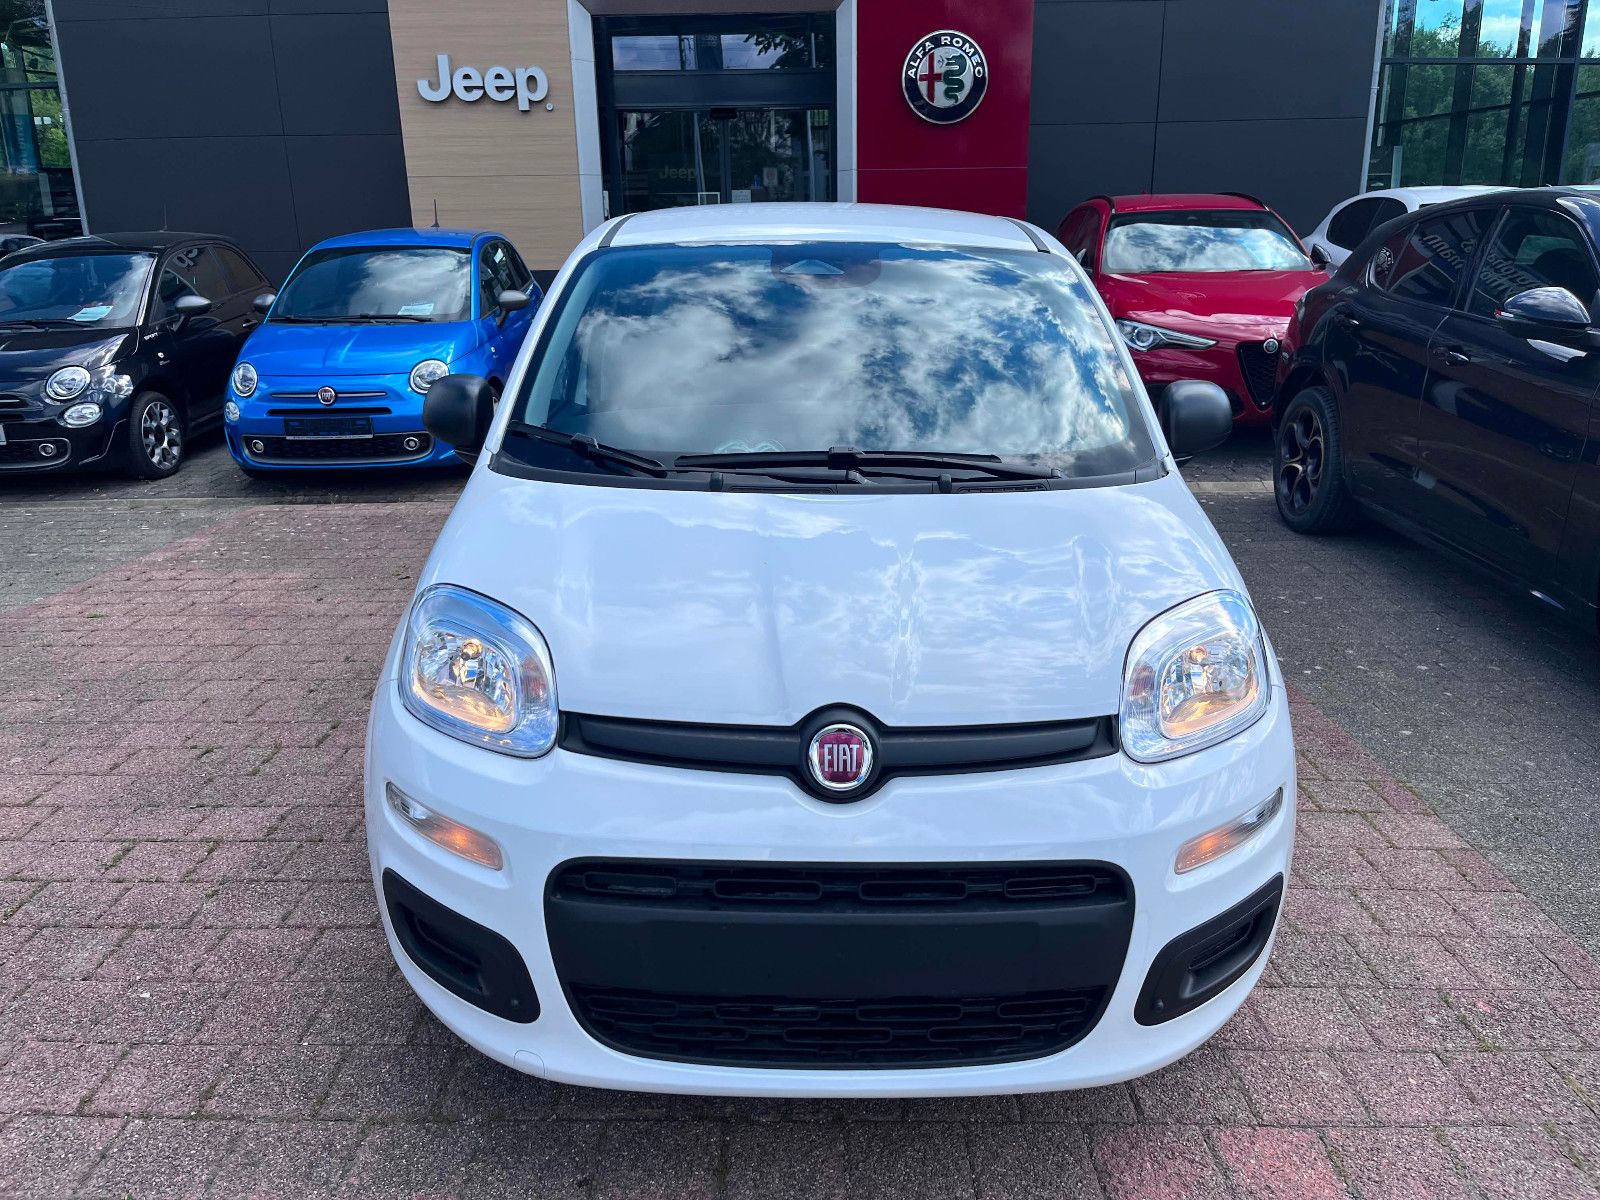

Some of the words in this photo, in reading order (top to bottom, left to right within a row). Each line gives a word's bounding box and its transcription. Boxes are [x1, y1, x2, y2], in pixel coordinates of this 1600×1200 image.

[907, 41, 935, 79] ALFA
[940, 36, 983, 78] ROMEO
[416, 54, 549, 111] Jeep
[823, 743, 860, 772] FIAT
